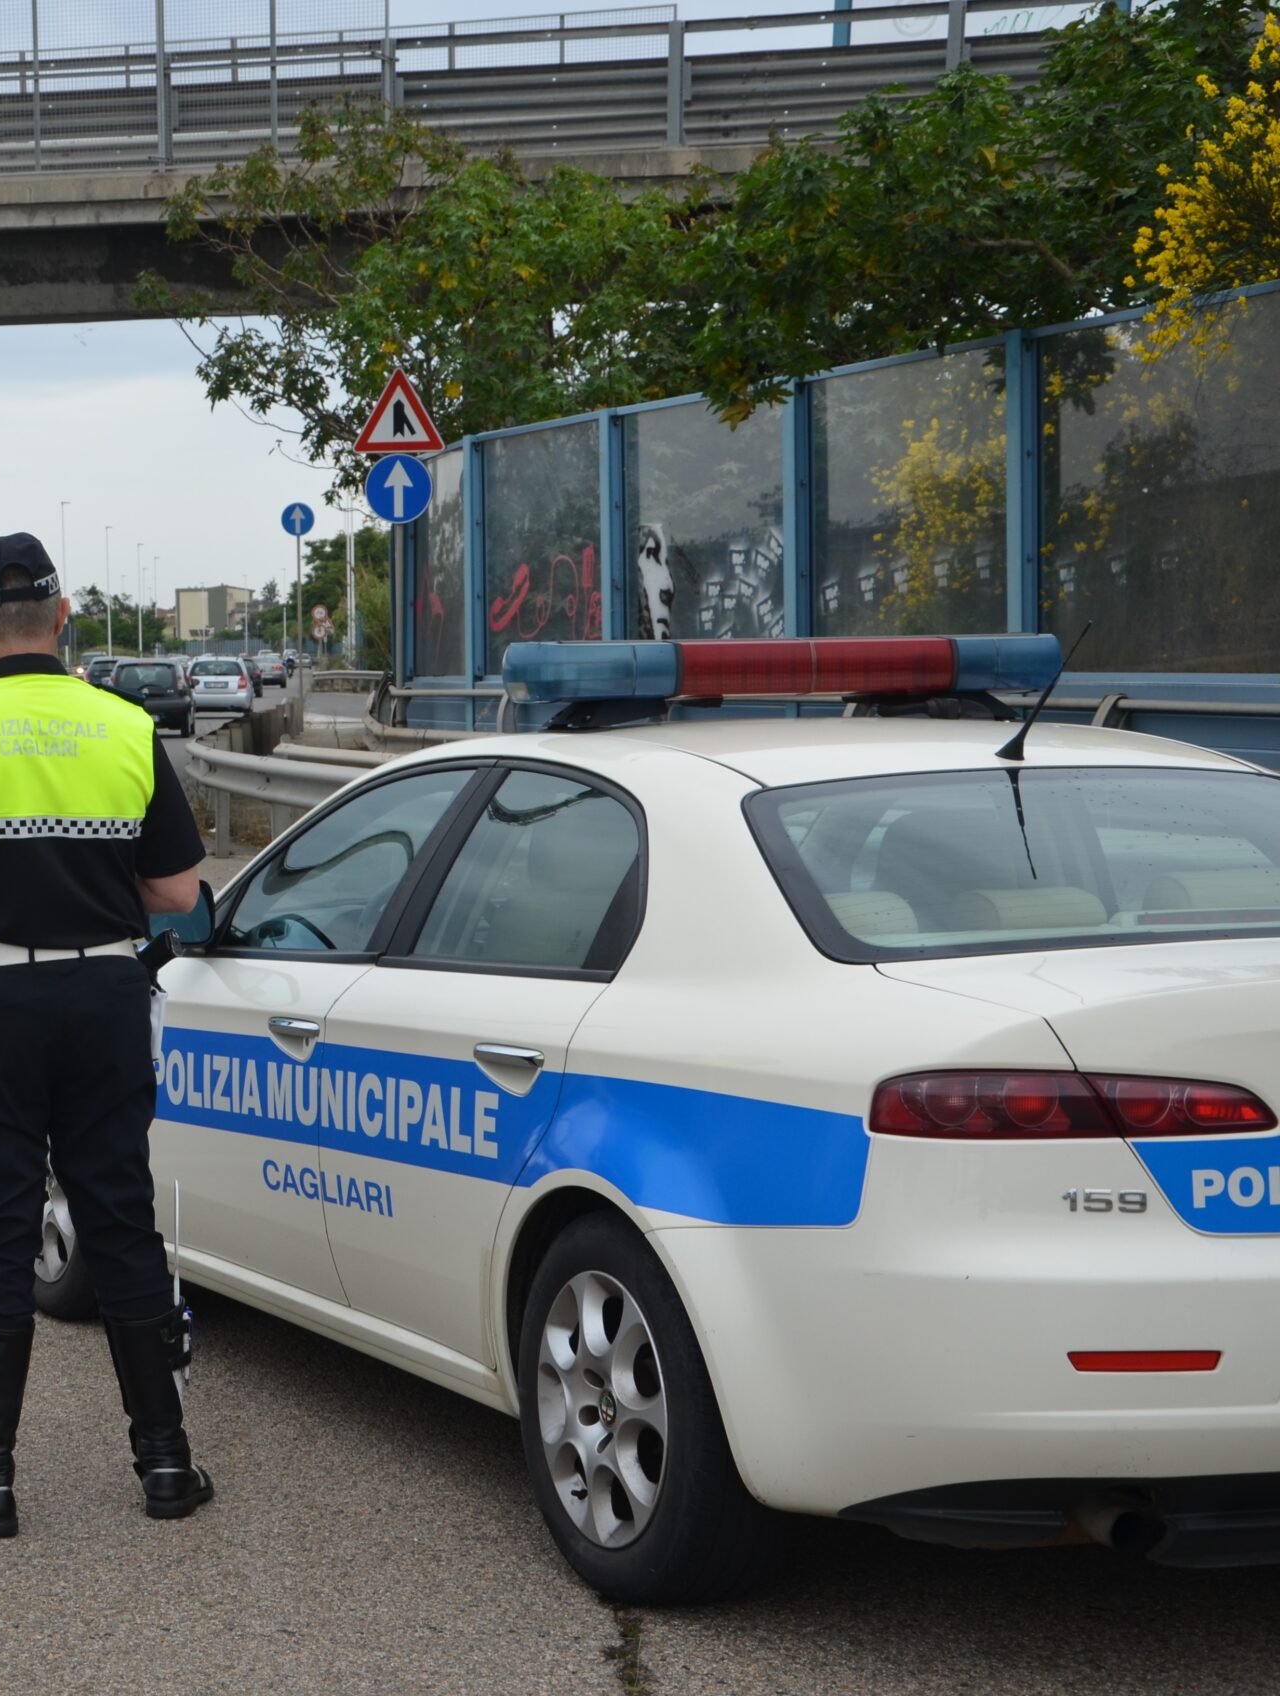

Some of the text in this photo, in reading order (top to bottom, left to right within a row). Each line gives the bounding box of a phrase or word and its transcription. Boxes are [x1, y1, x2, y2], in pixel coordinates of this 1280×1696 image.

[38, 719, 108, 739] LOCALE
[0, 739, 79, 758] CAGLIARI
[267, 1062, 499, 1159] MUNICIPALE
[263, 1159, 394, 1217] CAGLIARI
[1061, 1188, 1148, 1212] 159
